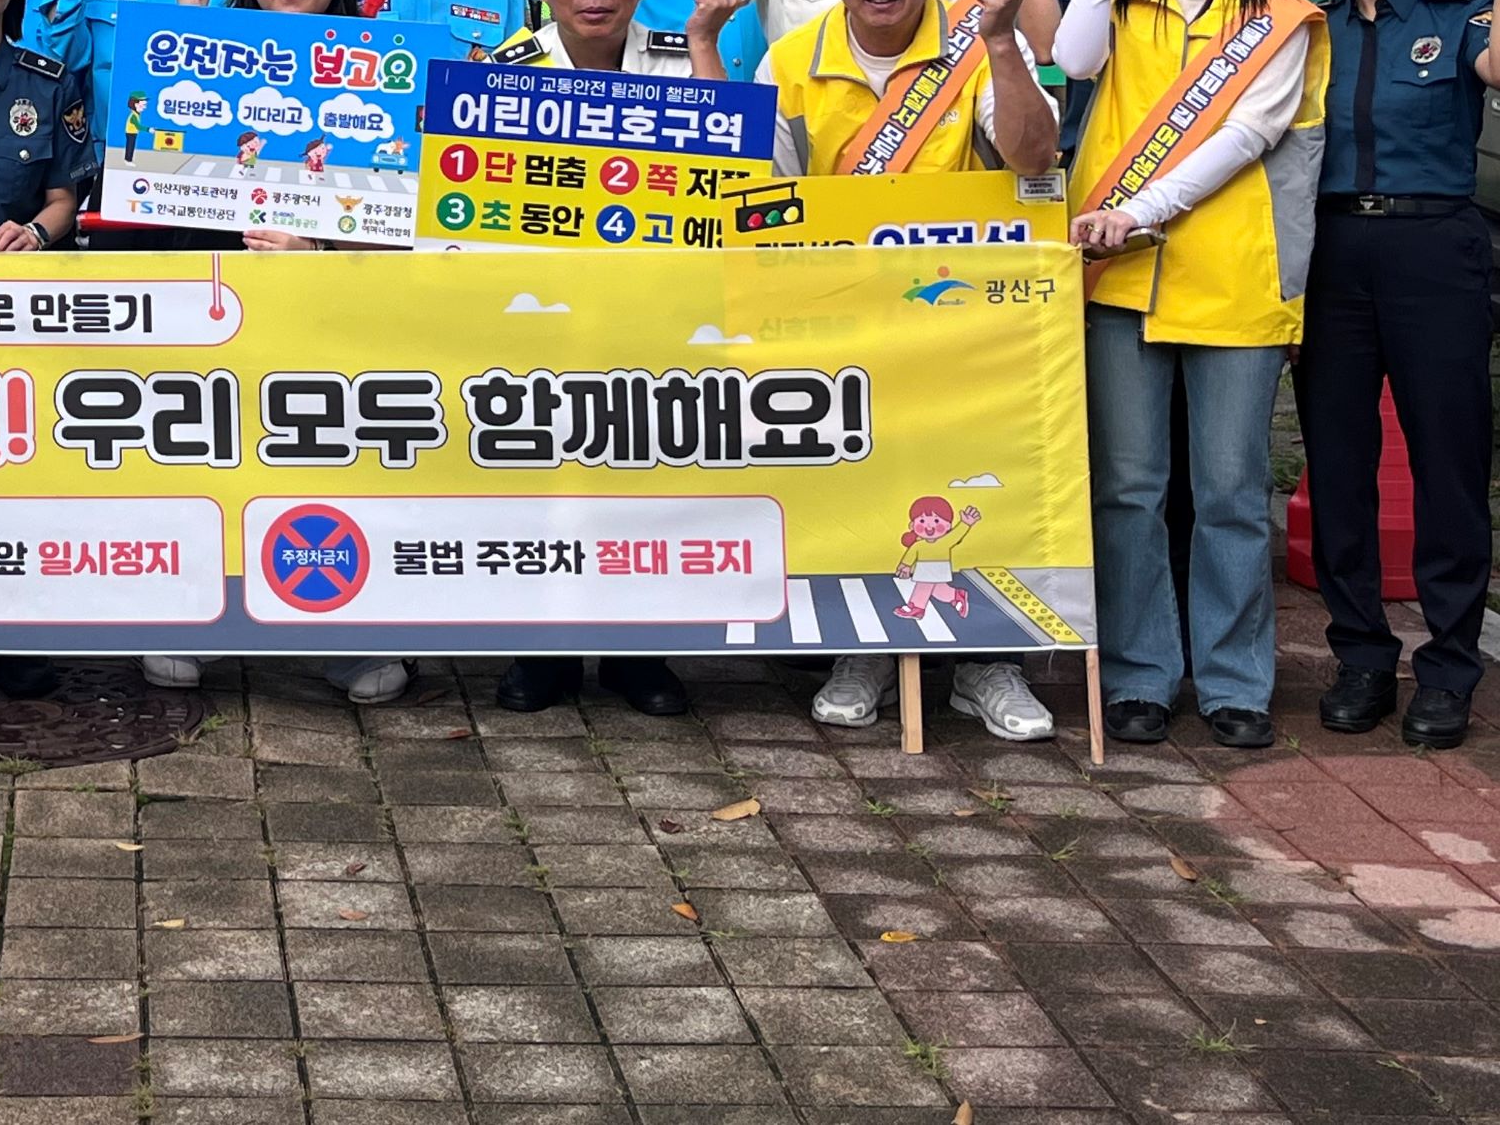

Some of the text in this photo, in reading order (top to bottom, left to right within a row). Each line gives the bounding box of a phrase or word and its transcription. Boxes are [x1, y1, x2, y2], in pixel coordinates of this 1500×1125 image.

[1223, 14, 1274, 63] 스쿨존
[147, 33, 414, 91] 운전자는 보고요
[486, 73, 717, 106] 어린이 교통안전 릴레이 챌린지
[890, 61, 950, 129] 교통질서
[1183, 56, 1238, 110] 살피는
[163, 98, 223, 119] 일단양보
[243, 105, 303, 126] 기다리고
[323, 112, 385, 133] 출발해요
[452, 93, 744, 153] 어린이보호구역
[1168, 102, 1197, 131] 길
[524, 155, 587, 189] 멈춤
[1119, 123, 1183, 194] 어린생명
[127, 200, 154, 215] TS
[153, 182, 239, 200] 익산지방국토관리청
[272, 192, 322, 207] 광주광역시
[157, 203, 237, 221] 한국교통안전공단
[363, 203, 413, 219] 광주경찰청
[520, 203, 585, 238] 동안
[985, 278, 1056, 305] 광산구
[30, 293, 153, 333] 만들기
[60, 375, 235, 461] 우리
[266, 375, 441, 460] 모두
[467, 372, 866, 461] 함께해요!
[39, 539, 178, 576] 일시정지
[281, 547, 350, 567] 주정차금지
[393, 539, 752, 576] 불법 주정차 절대 금지
